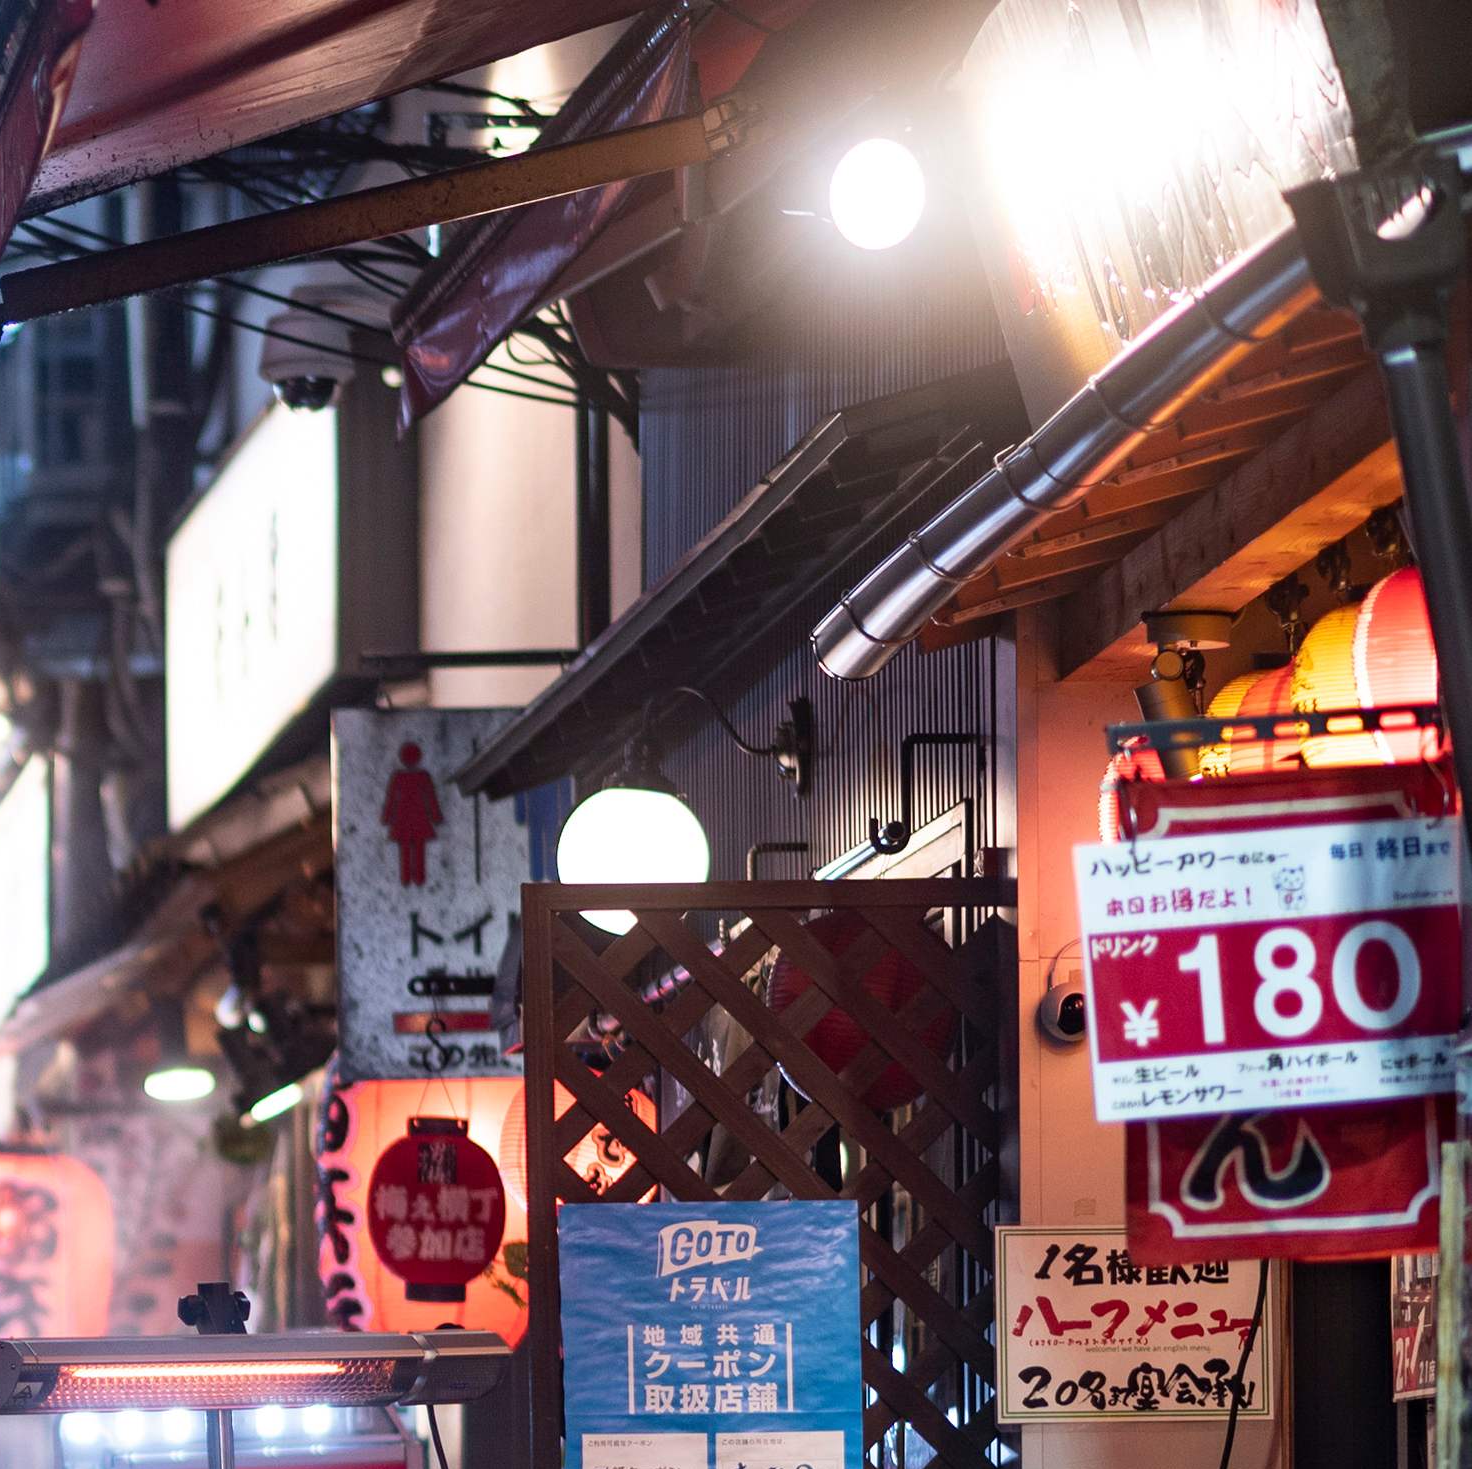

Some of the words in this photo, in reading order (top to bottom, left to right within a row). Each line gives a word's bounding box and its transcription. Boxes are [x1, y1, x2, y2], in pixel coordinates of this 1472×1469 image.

[410, 911, 520, 957] トイ
[1091, 934, 1159, 961] ドリンク
[669, 1276, 753, 1303] トラベル
[1012, 1295, 1261, 1340] ハーフメニュー
[643, 1323, 777, 1346] 地域共通
[1133, 1345, 1151, 1353] have
[1163, 1344, 1188, 1354] english
[644, 1351, 777, 1379] クーポン
[644, 1383, 778, 1413] 取扱店舗
